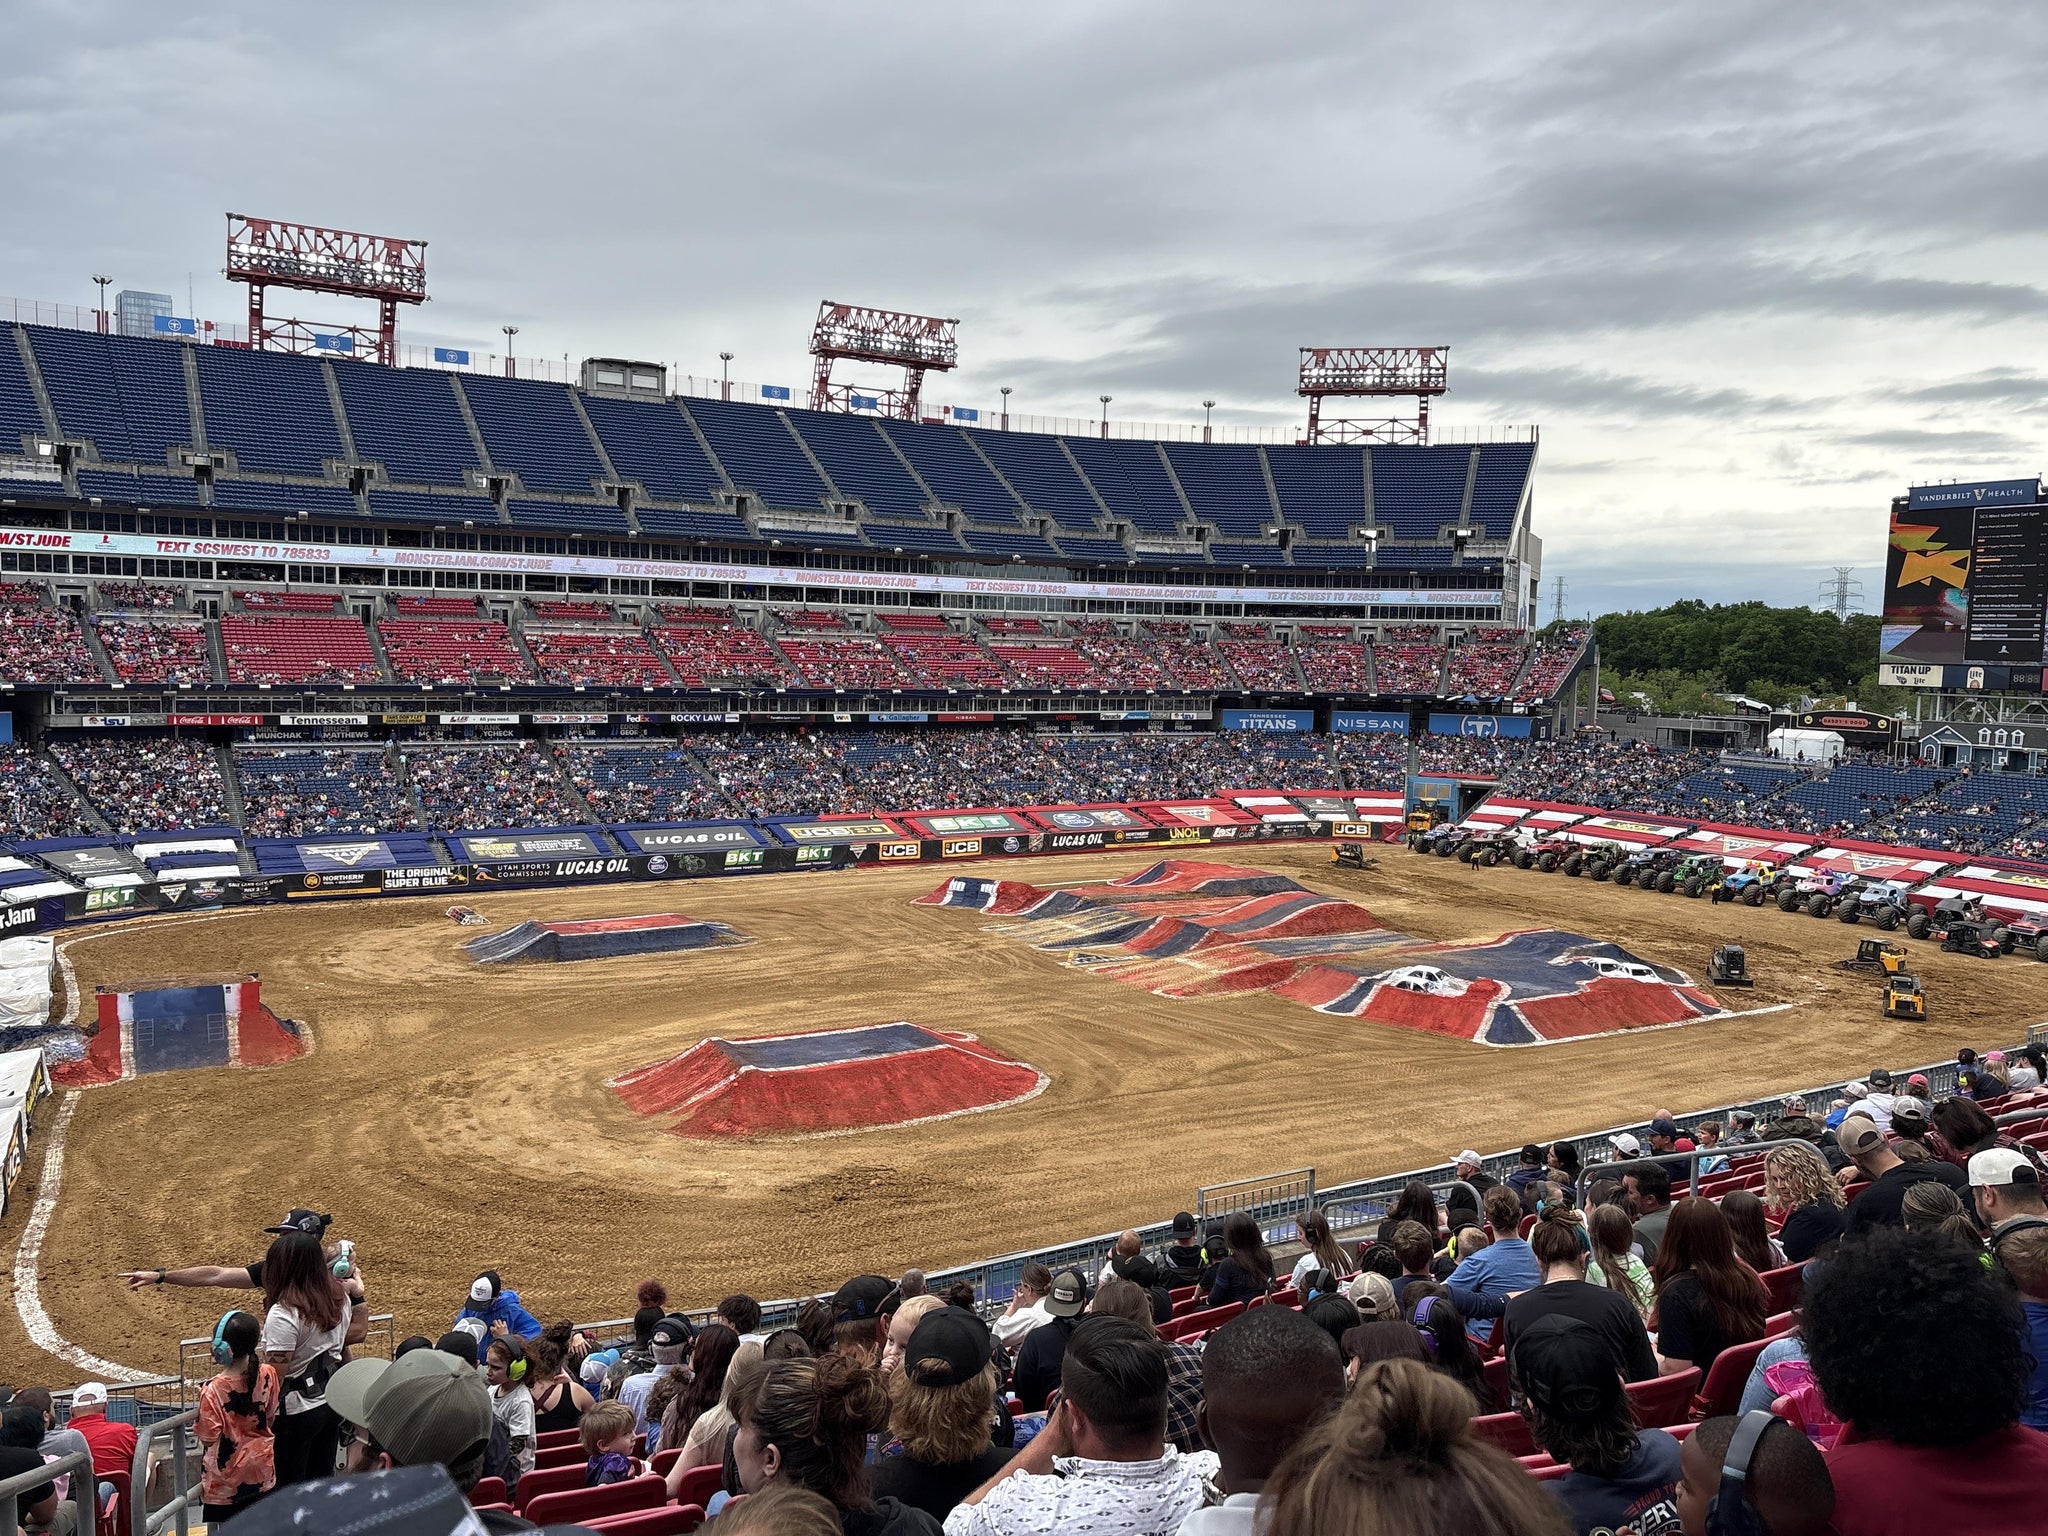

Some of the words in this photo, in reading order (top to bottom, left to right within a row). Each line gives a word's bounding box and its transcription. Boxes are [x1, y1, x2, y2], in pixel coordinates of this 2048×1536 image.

[1919, 492, 1971, 502] VANDERBILT
[1987, 488, 2023, 497] HEALTH
[156, 540, 191, 553] TEXT
[193, 543, 259, 557] SCSWEST
[261, 546, 278, 557] TO
[282, 547, 331, 561] 785833
[394, 552, 553, 570] MONSTERJAM.COM/STJUDE
[615, 563, 642, 574] TEXT
[643, 563, 694, 577] SCSWEST
[694, 567, 707, 577] TO
[795, 572, 918, 588] MONSTERJAM.COM/STJUDE
[965, 581, 986, 591] TEXT
[987, 581, 1025, 593] SCSWEST
[1026, 583, 1037, 593] TO
[1106, 587, 1218, 600] MONSTERJAM.COM/STJUDE
[1267, 591, 1289, 601] TEXT
[1333, 592, 1346, 601] TO
[1890, 665, 1919, 674] TITAN
[1918, 665, 1932, 675] UP
[1969, 670, 1982, 679] Lite
[179, 715, 205, 725] Coca-Cola
[227, 715, 252, 725] Coca-Cola
[670, 714, 701, 722] ROCKY
[703, 714, 723, 722] LAW
[1337, 718, 1405, 730] NISSAN
[1239, 719, 1297, 730] TITANS
[935, 815, 1003, 829] BKT
[1169, 827, 1200, 839] UNOH
[1335, 824, 1368, 835] JCB
[643, 834, 710, 846] LUCAS
[1052, 834, 1085, 847] LUCAS
[796, 847, 833, 859] BKT
[882, 843, 918, 857] JCB
[945, 841, 979, 854] JCB
[725, 851, 764, 864] BKT
[385, 869, 406, 879] THE
[407, 867, 453, 877] ORIGINAL
[497, 870, 551, 878] COMMISSION
[555, 860, 604, 876] LUCAS
[322, 873, 364, 882] NORTHERN
[385, 878, 420, 888] SUPER
[422, 877, 448, 886] GLUE
[86, 888, 135, 908] BKT
[1635, 1488, 1662, 1511] PROUD
[1663, 1483, 1676, 1495] TO
